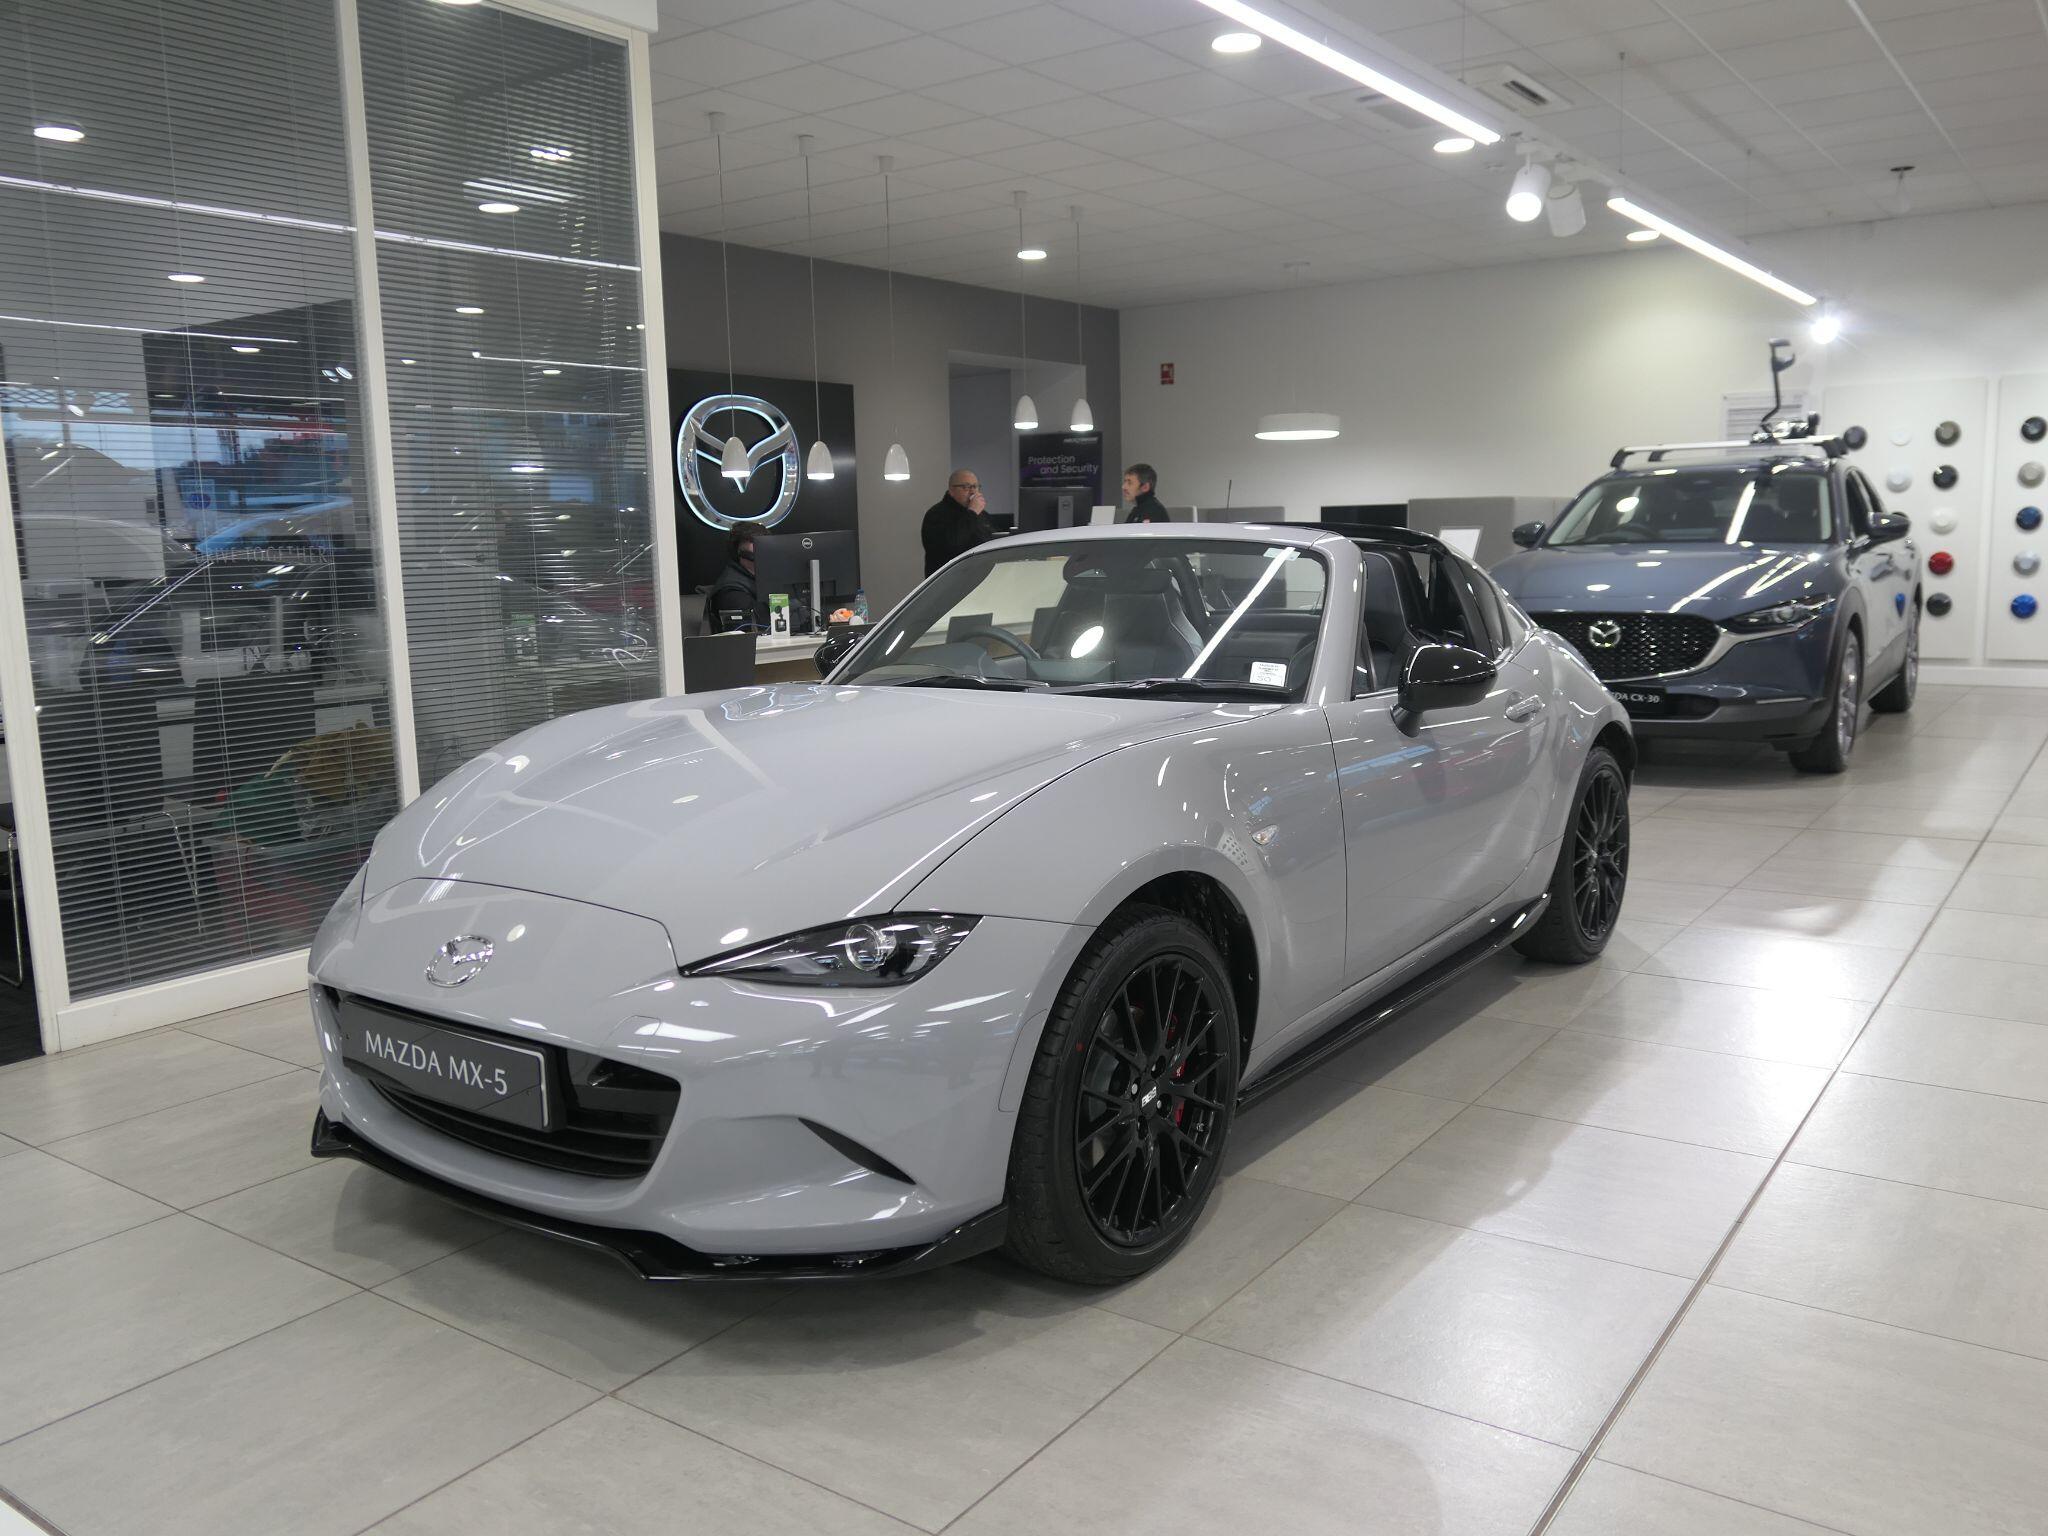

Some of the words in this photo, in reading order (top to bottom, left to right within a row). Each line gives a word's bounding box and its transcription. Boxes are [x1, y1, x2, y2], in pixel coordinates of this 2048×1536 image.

[1027, 455, 1076, 465] Protection
[1040, 466, 1059, 475] and
[1061, 464, 1099, 476] Security
[1630, 693, 1660, 703] CX-30
[366, 1030, 443, 1077] MAZDA
[450, 1055, 508, 1096] MX-5
[1141, 1086, 1157, 1108] BBS
